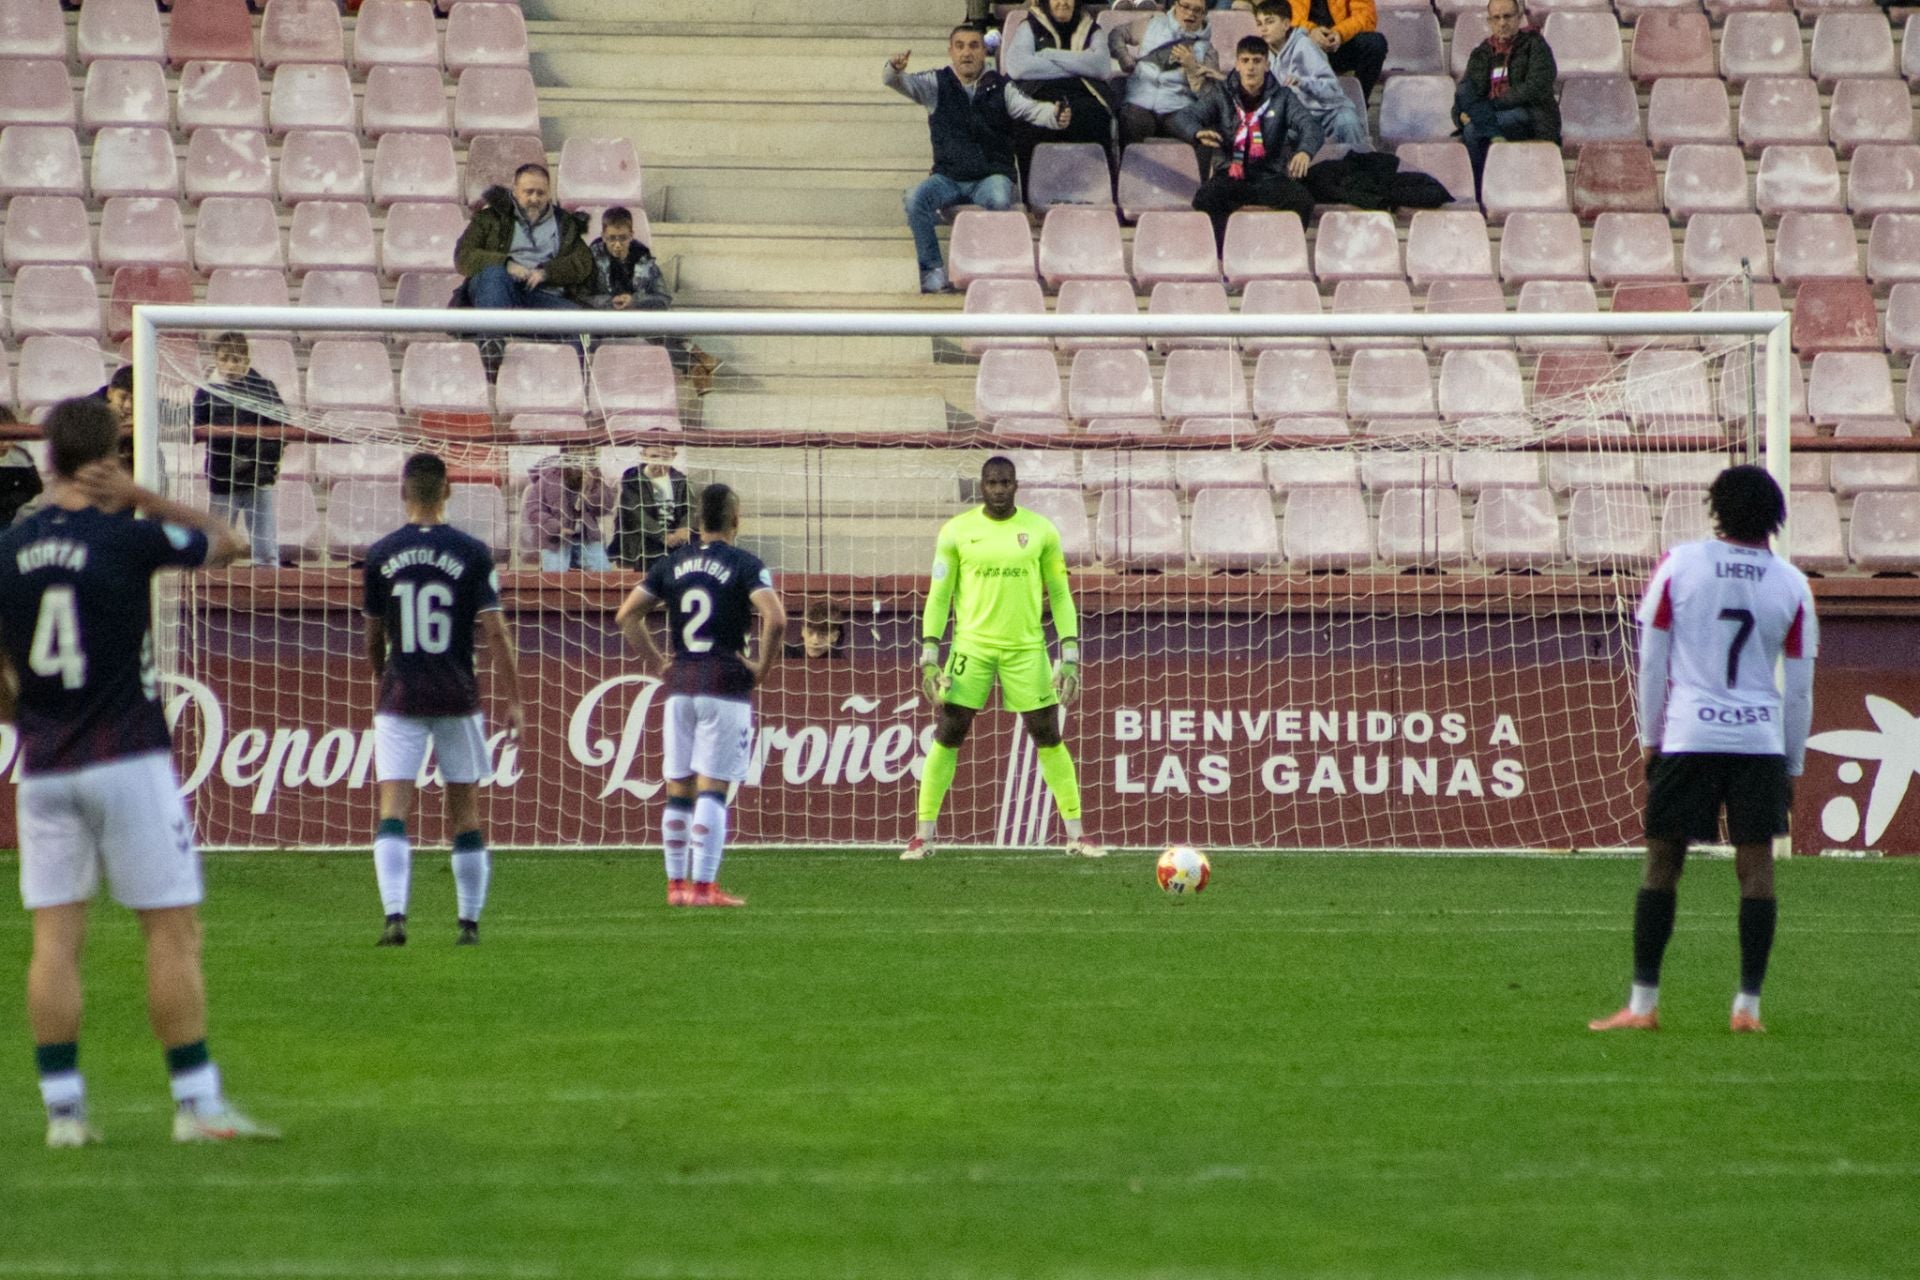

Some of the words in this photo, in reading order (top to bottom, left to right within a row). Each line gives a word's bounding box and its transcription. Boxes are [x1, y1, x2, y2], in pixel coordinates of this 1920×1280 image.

[674, 556, 732, 585] AMILIBIA
[1715, 561, 1767, 582] LHERY
[28, 585, 87, 690] 4
[391, 582, 454, 654] 16
[680, 588, 715, 653] 2
[950, 651, 968, 676] 13
[1718, 608, 1756, 689] 7
[1114, 709, 1467, 744] BIENVENIDOS
[1489, 714, 1520, 746] A
[1698, 706, 1771, 724] ocisa
[1114, 754, 1232, 794] LAS
[1261, 755, 1526, 799] GAUNAS
